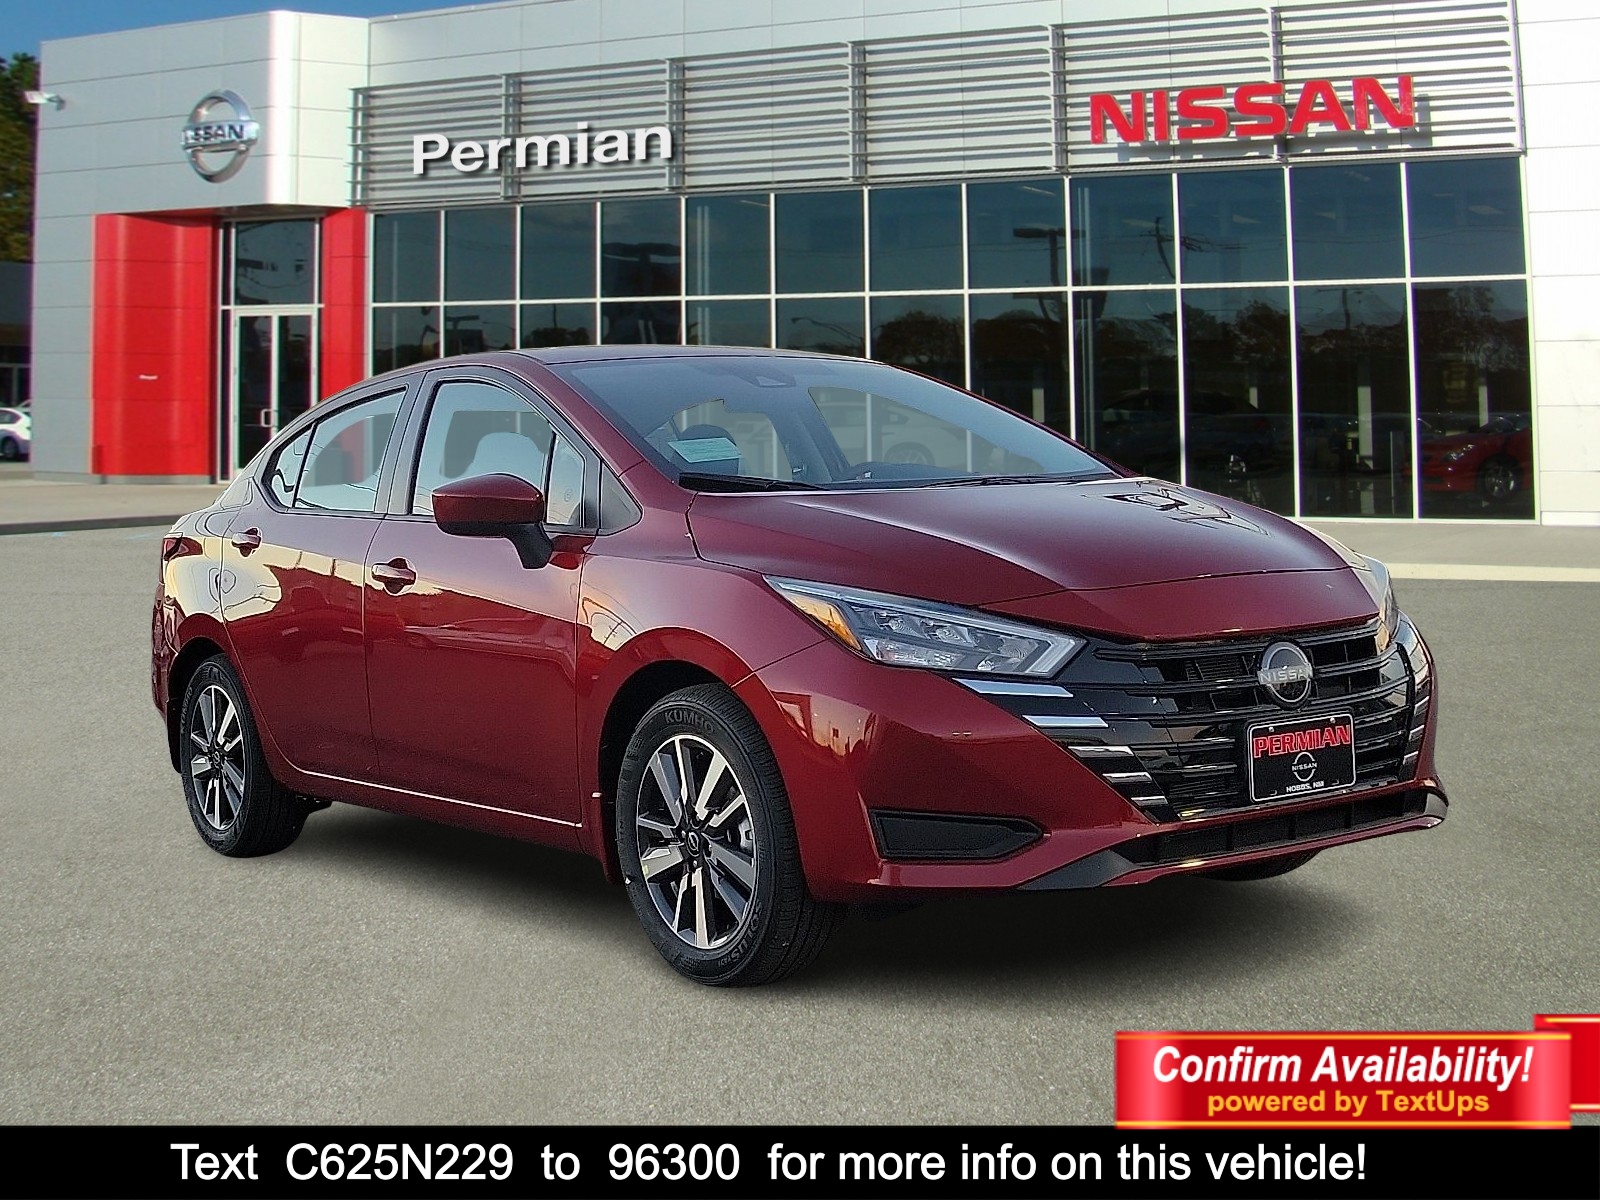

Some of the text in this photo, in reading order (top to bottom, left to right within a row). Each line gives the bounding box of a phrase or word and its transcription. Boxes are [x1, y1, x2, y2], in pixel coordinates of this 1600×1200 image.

[1090, 74, 1415, 144] NISSAN
[413, 121, 672, 175] Permian
[664, 709, 715, 733] KUMHO
[1253, 725, 1350, 758] PERMIAN
[1291, 762, 1318, 771] NISSAN
